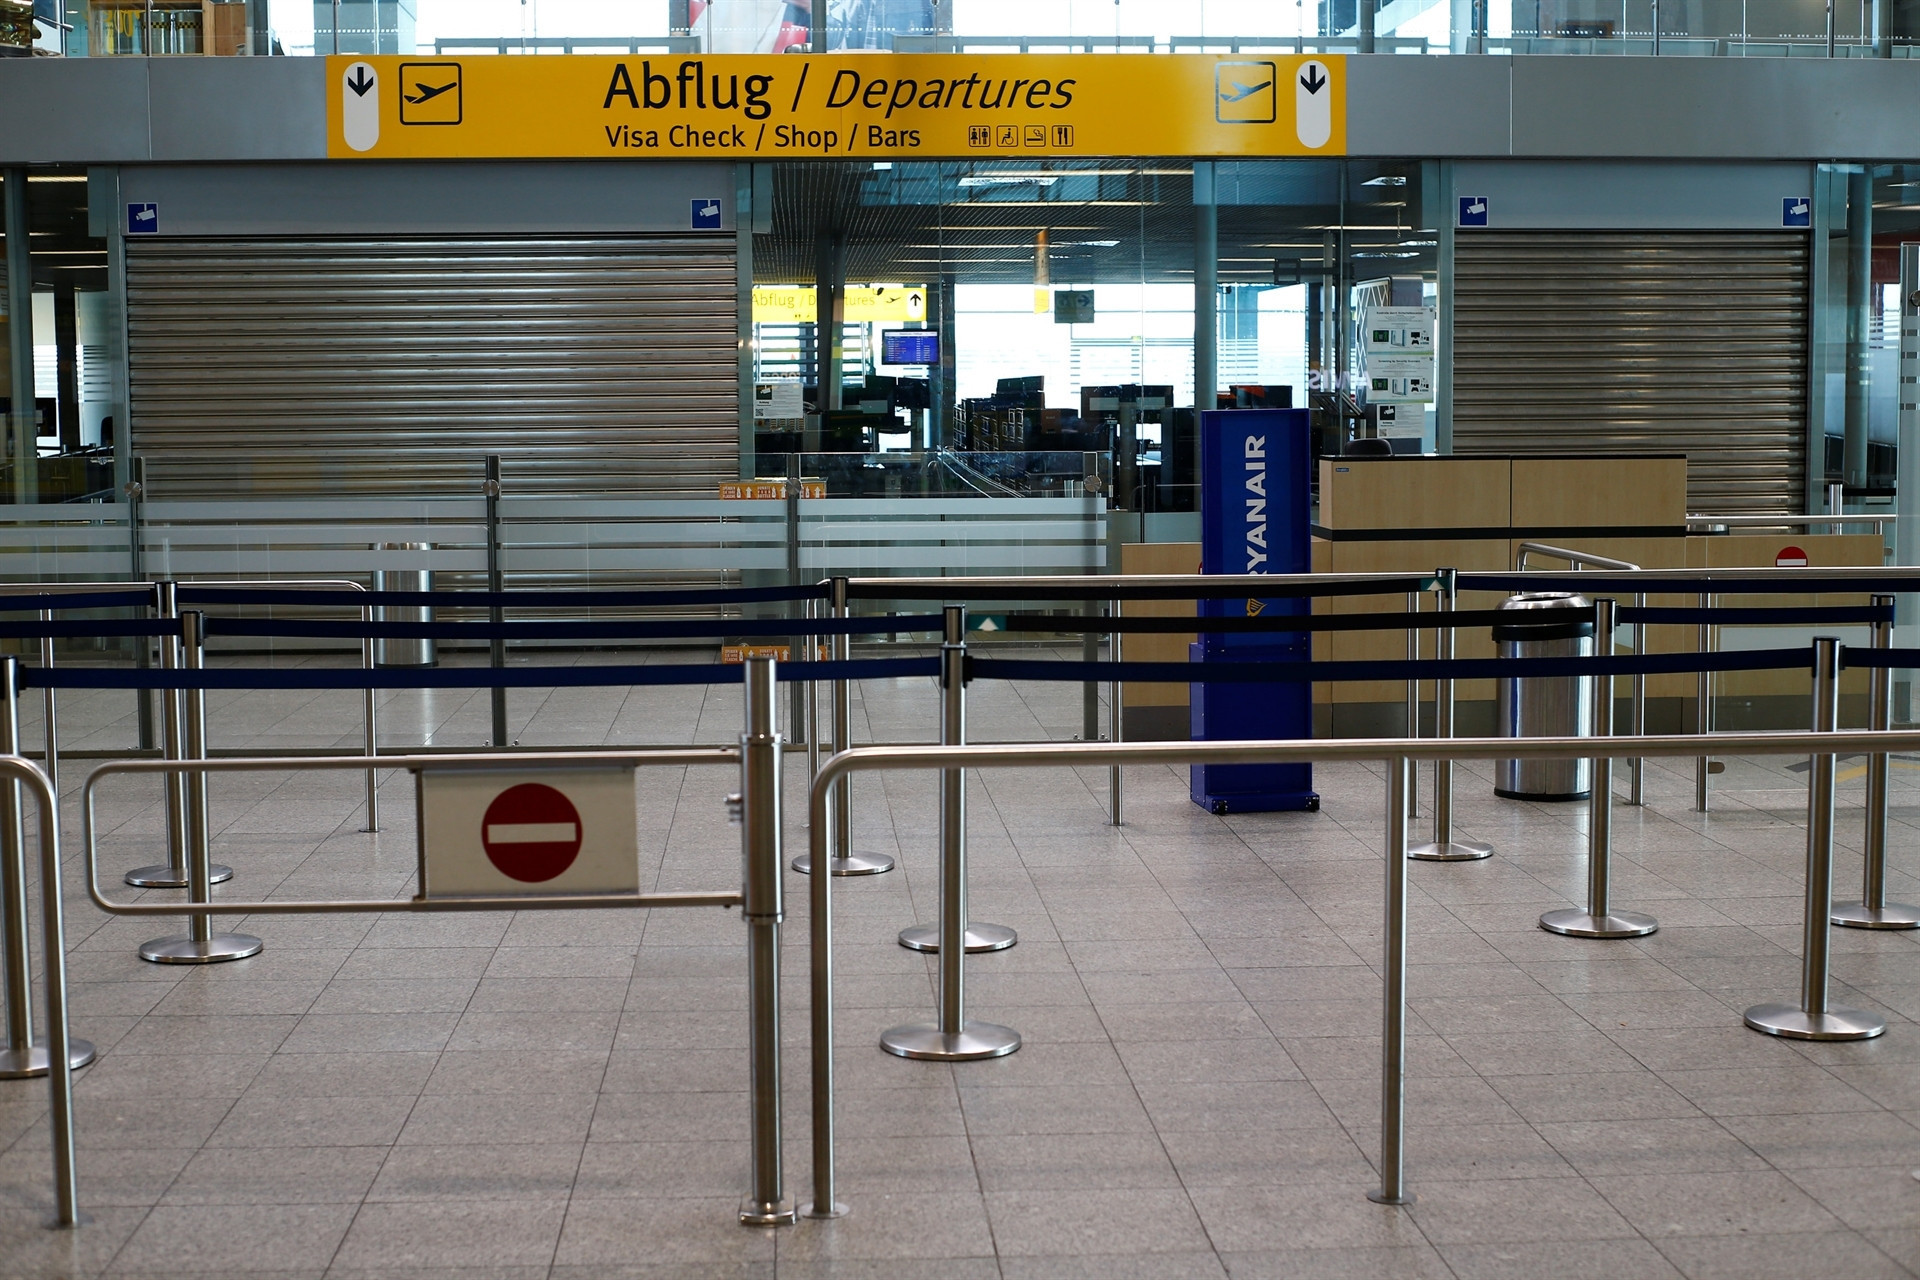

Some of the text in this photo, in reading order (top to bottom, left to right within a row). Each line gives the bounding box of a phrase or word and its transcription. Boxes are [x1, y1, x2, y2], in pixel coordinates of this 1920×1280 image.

[603, 61, 1077, 120] Abflug / Departures
[605, 123, 921, 153] Visa Check / Shop / Bars
[752, 293, 794, 308] Abflug
